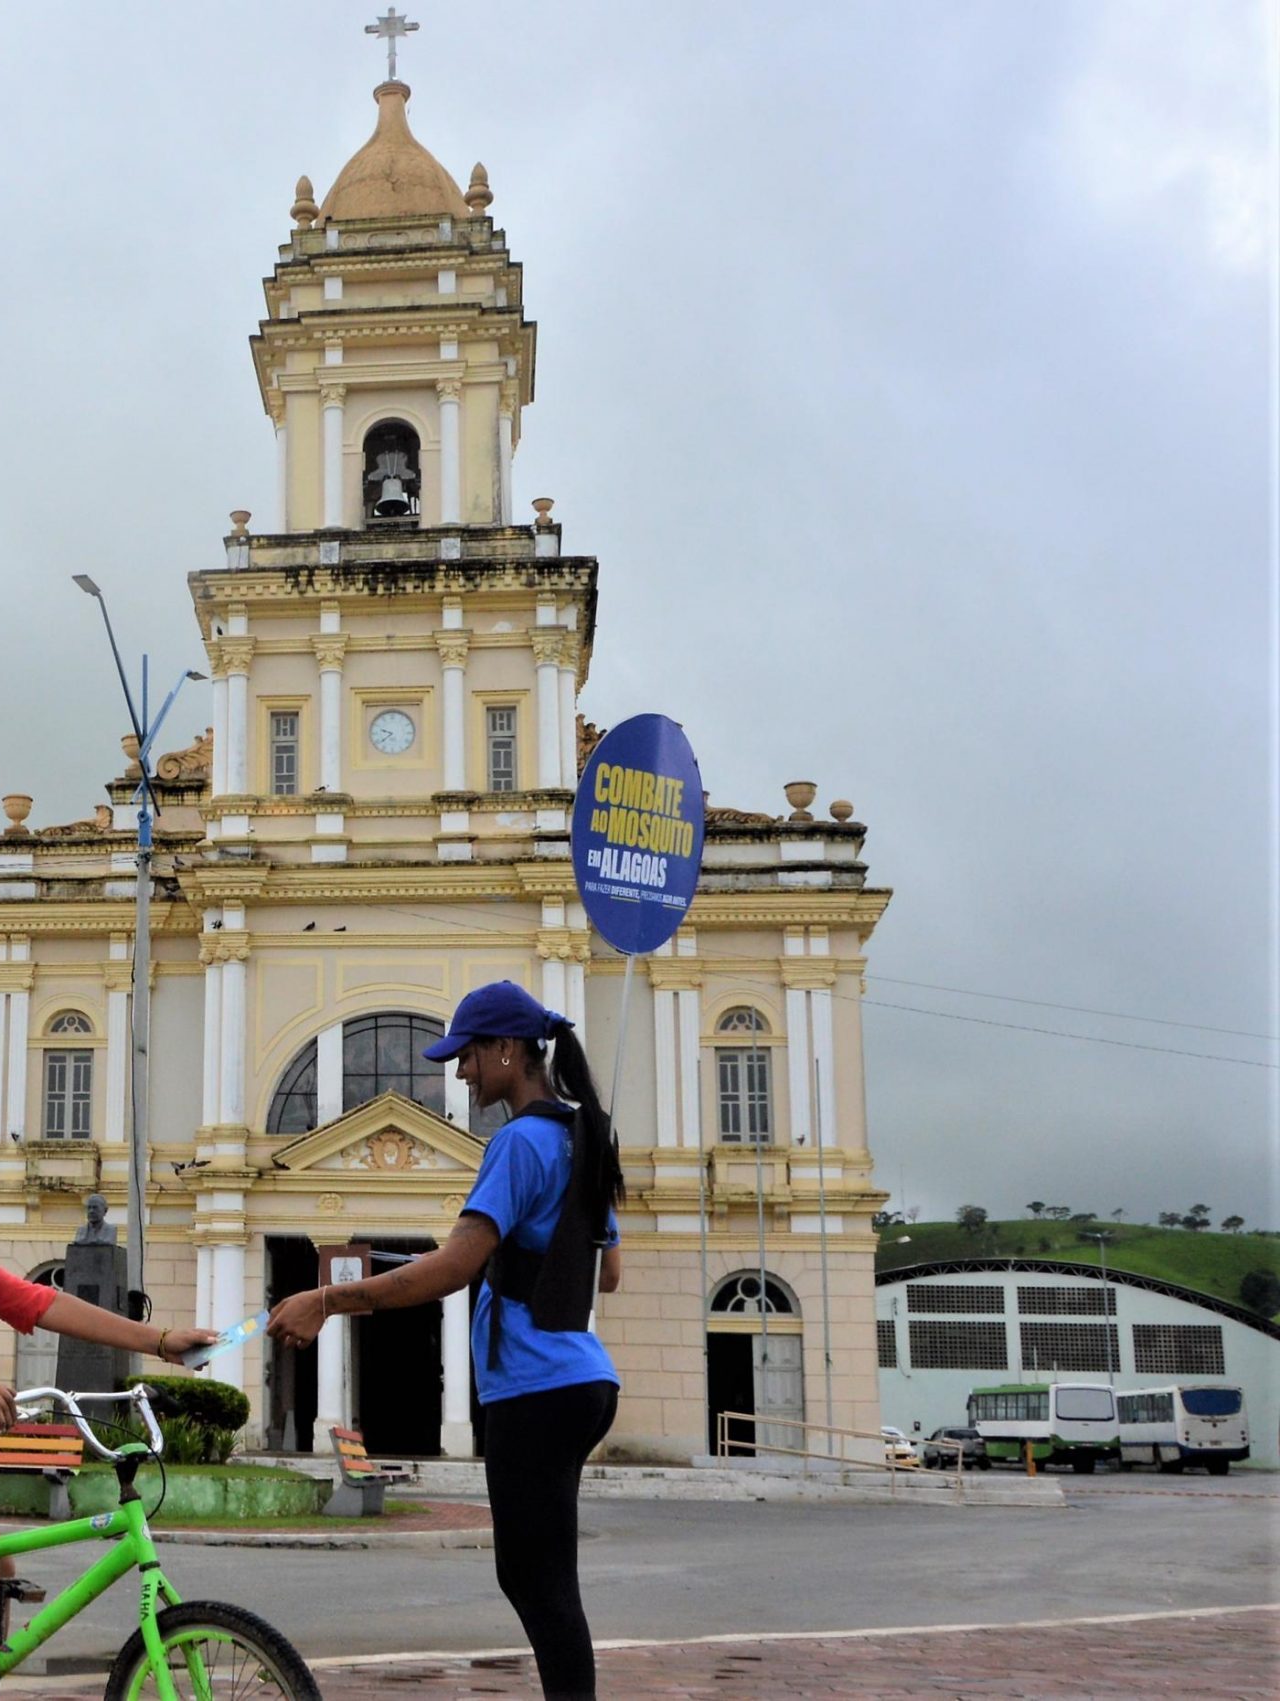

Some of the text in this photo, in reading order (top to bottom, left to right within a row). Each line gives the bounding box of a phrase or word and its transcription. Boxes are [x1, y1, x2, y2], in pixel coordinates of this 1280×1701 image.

[595, 763, 684, 817] COMBATE
[590, 806, 694, 858] AO MOSQUITO
[587, 847, 667, 889] EM ALAGOAS
